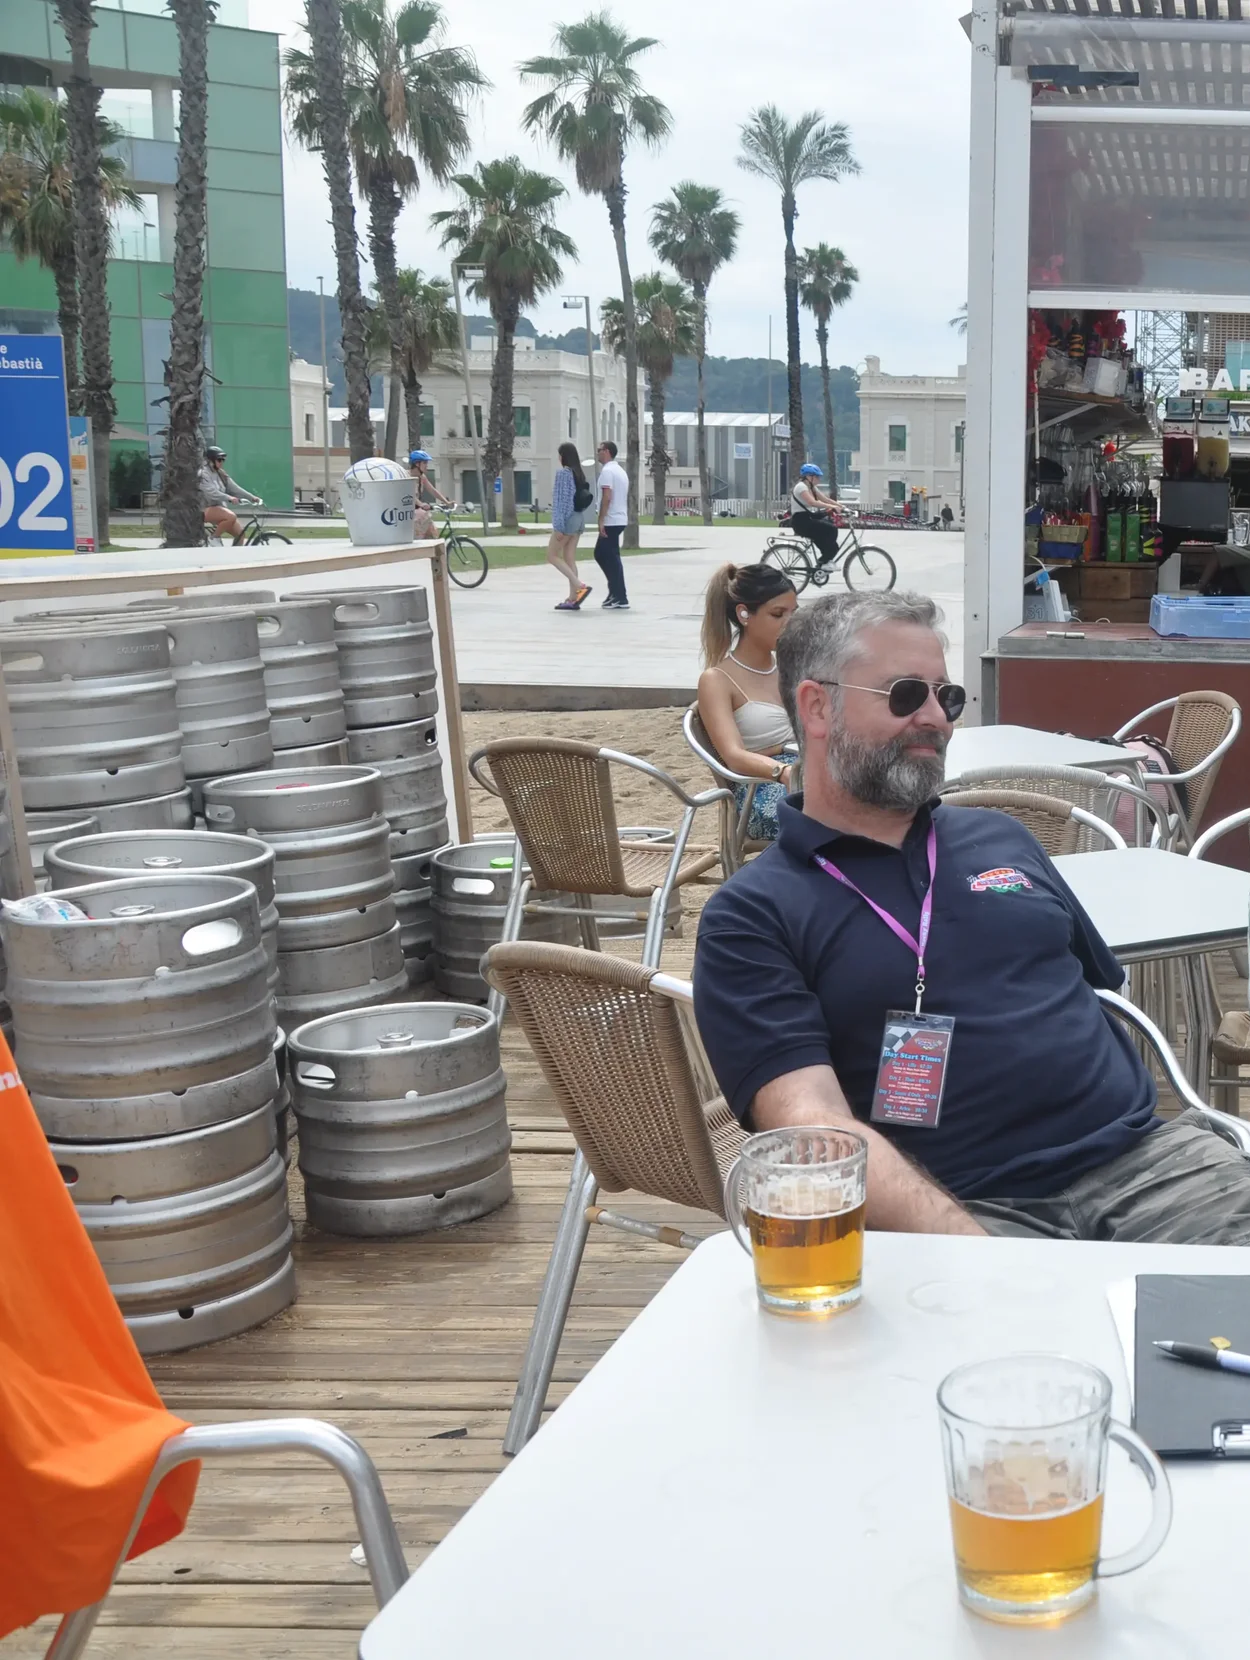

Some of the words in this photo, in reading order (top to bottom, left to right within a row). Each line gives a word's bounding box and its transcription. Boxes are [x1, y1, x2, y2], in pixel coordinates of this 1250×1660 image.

[0, 356, 44, 370] bastià
[885, 1051, 898, 1059] Day
[900, 1052, 919, 1060] Start
[921, 1054, 942, 1062] Times
